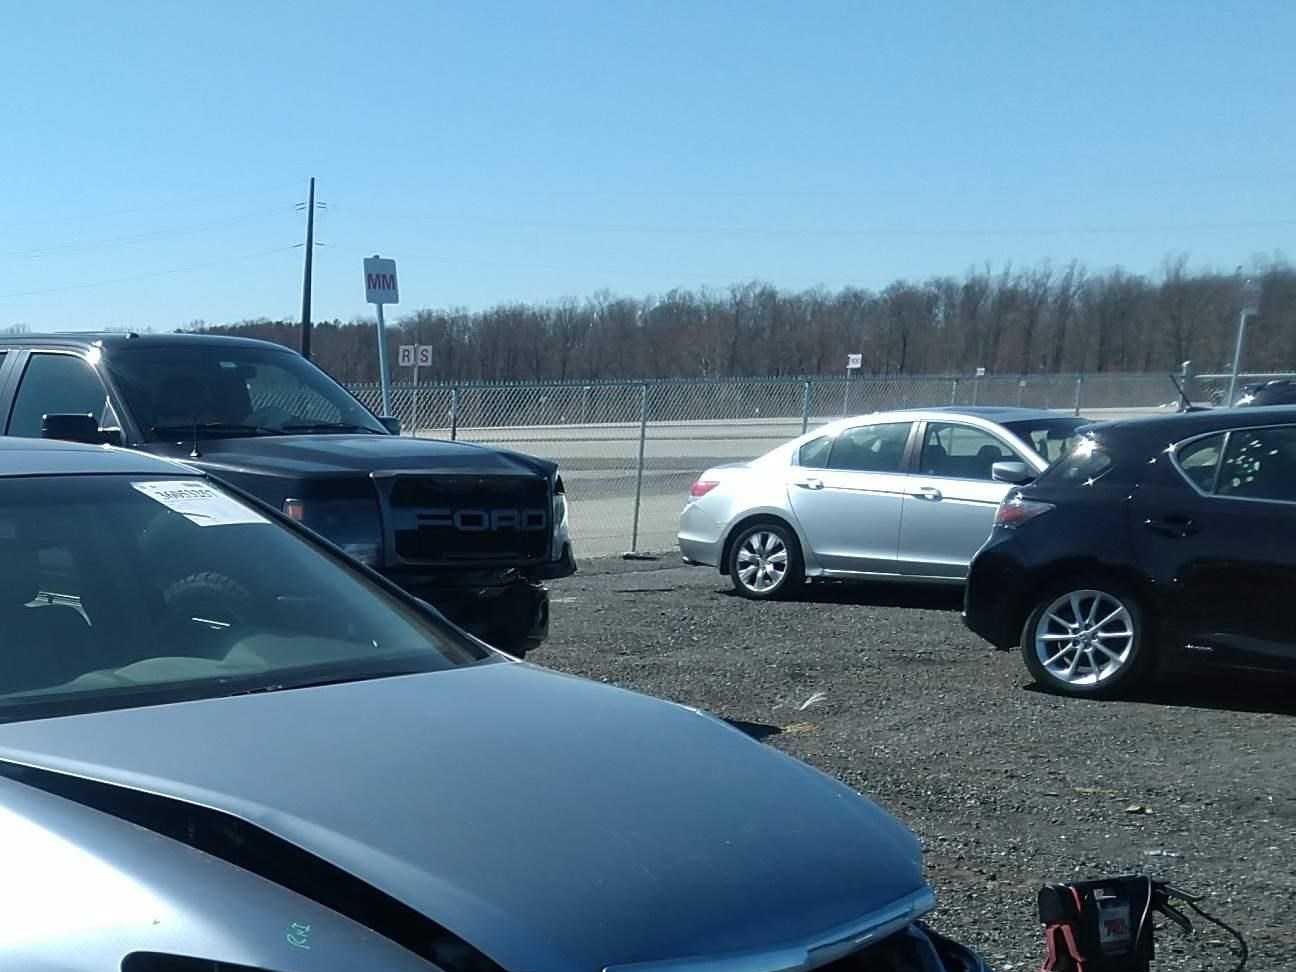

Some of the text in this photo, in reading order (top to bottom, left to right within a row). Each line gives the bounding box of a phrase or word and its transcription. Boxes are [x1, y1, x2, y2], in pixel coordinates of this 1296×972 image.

[367, 273, 396, 291] MM
[401, 349, 411, 363] R
[419, 348, 429, 363] S
[416, 507, 546, 532] FORD
